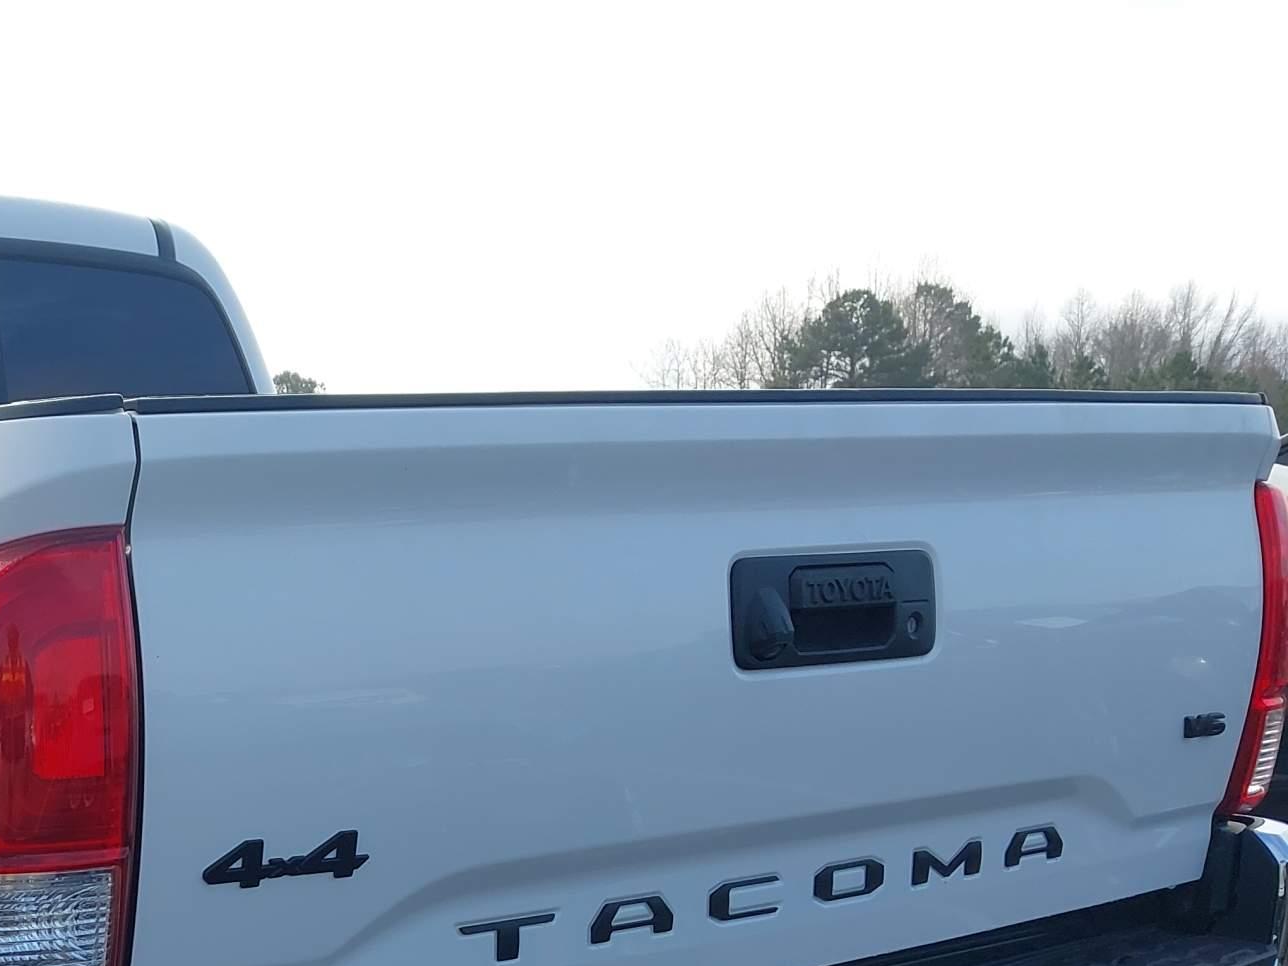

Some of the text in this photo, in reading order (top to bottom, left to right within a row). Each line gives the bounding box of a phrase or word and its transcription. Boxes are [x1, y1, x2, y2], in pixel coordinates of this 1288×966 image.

[806, 576, 895, 605] TOYOTA
[1183, 712, 1226, 739] V6
[202, 829, 370, 889] 4x4
[457, 823, 1064, 963] TACOMA
